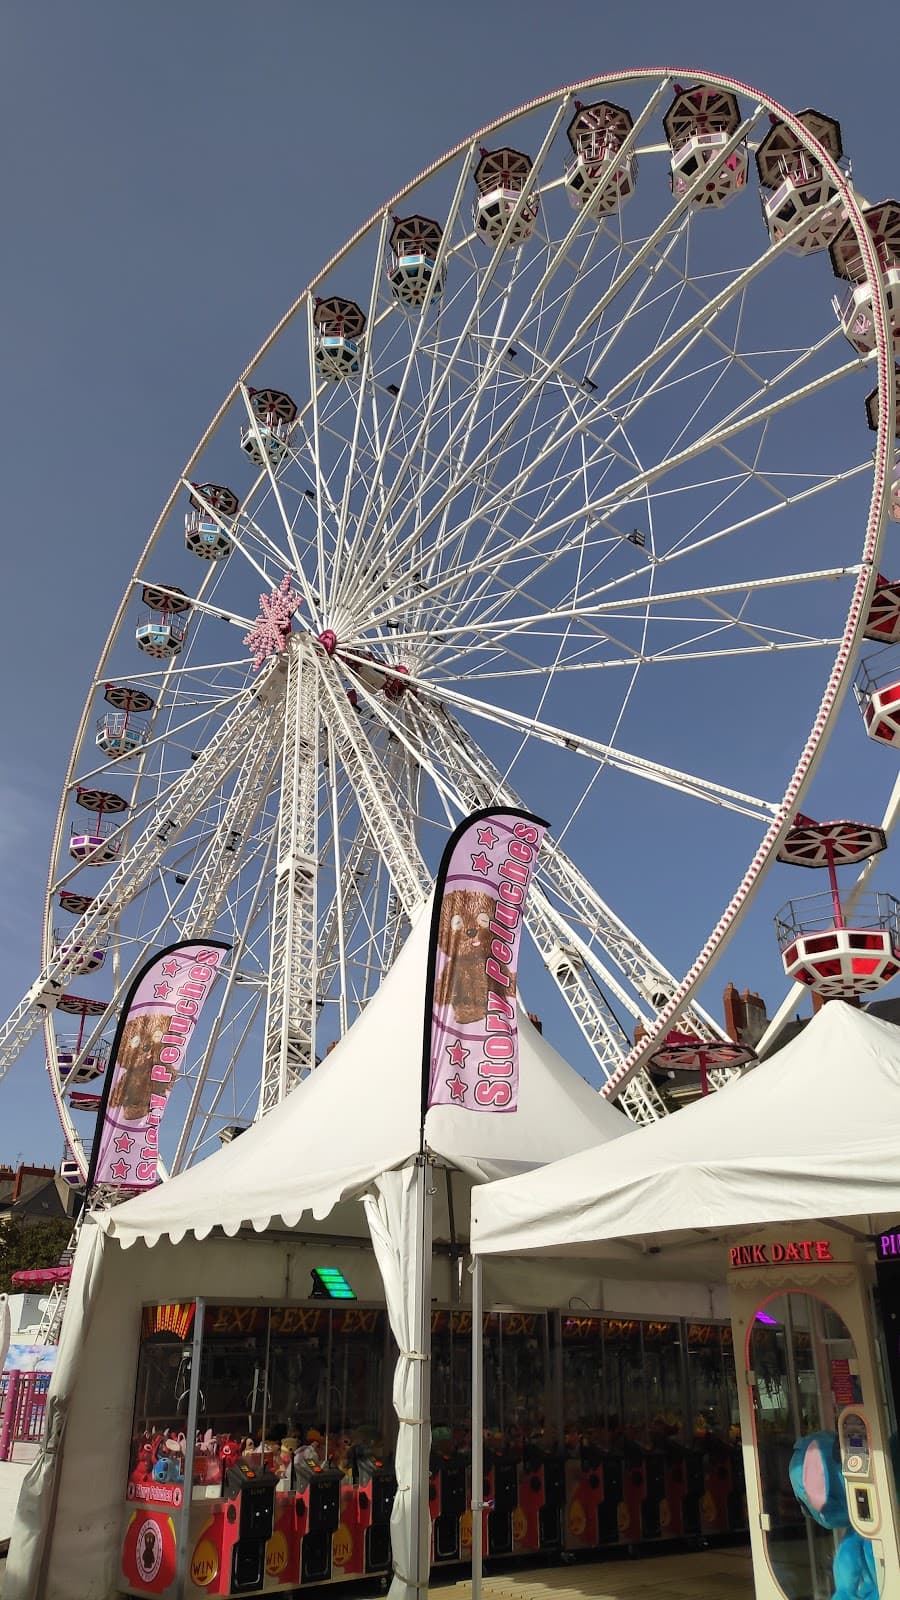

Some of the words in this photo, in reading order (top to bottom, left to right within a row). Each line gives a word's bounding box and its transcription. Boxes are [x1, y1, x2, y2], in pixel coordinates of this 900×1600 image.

[485, 822, 540, 986] Peluches
[150, 949, 220, 1083] Peluches
[474, 988, 516, 1107] Story
[136, 1093, 168, 1181] Story
[730, 1244, 768, 1266] PINK
[771, 1241, 833, 1262] DATE
[192, 1560, 214, 1574] WIN
